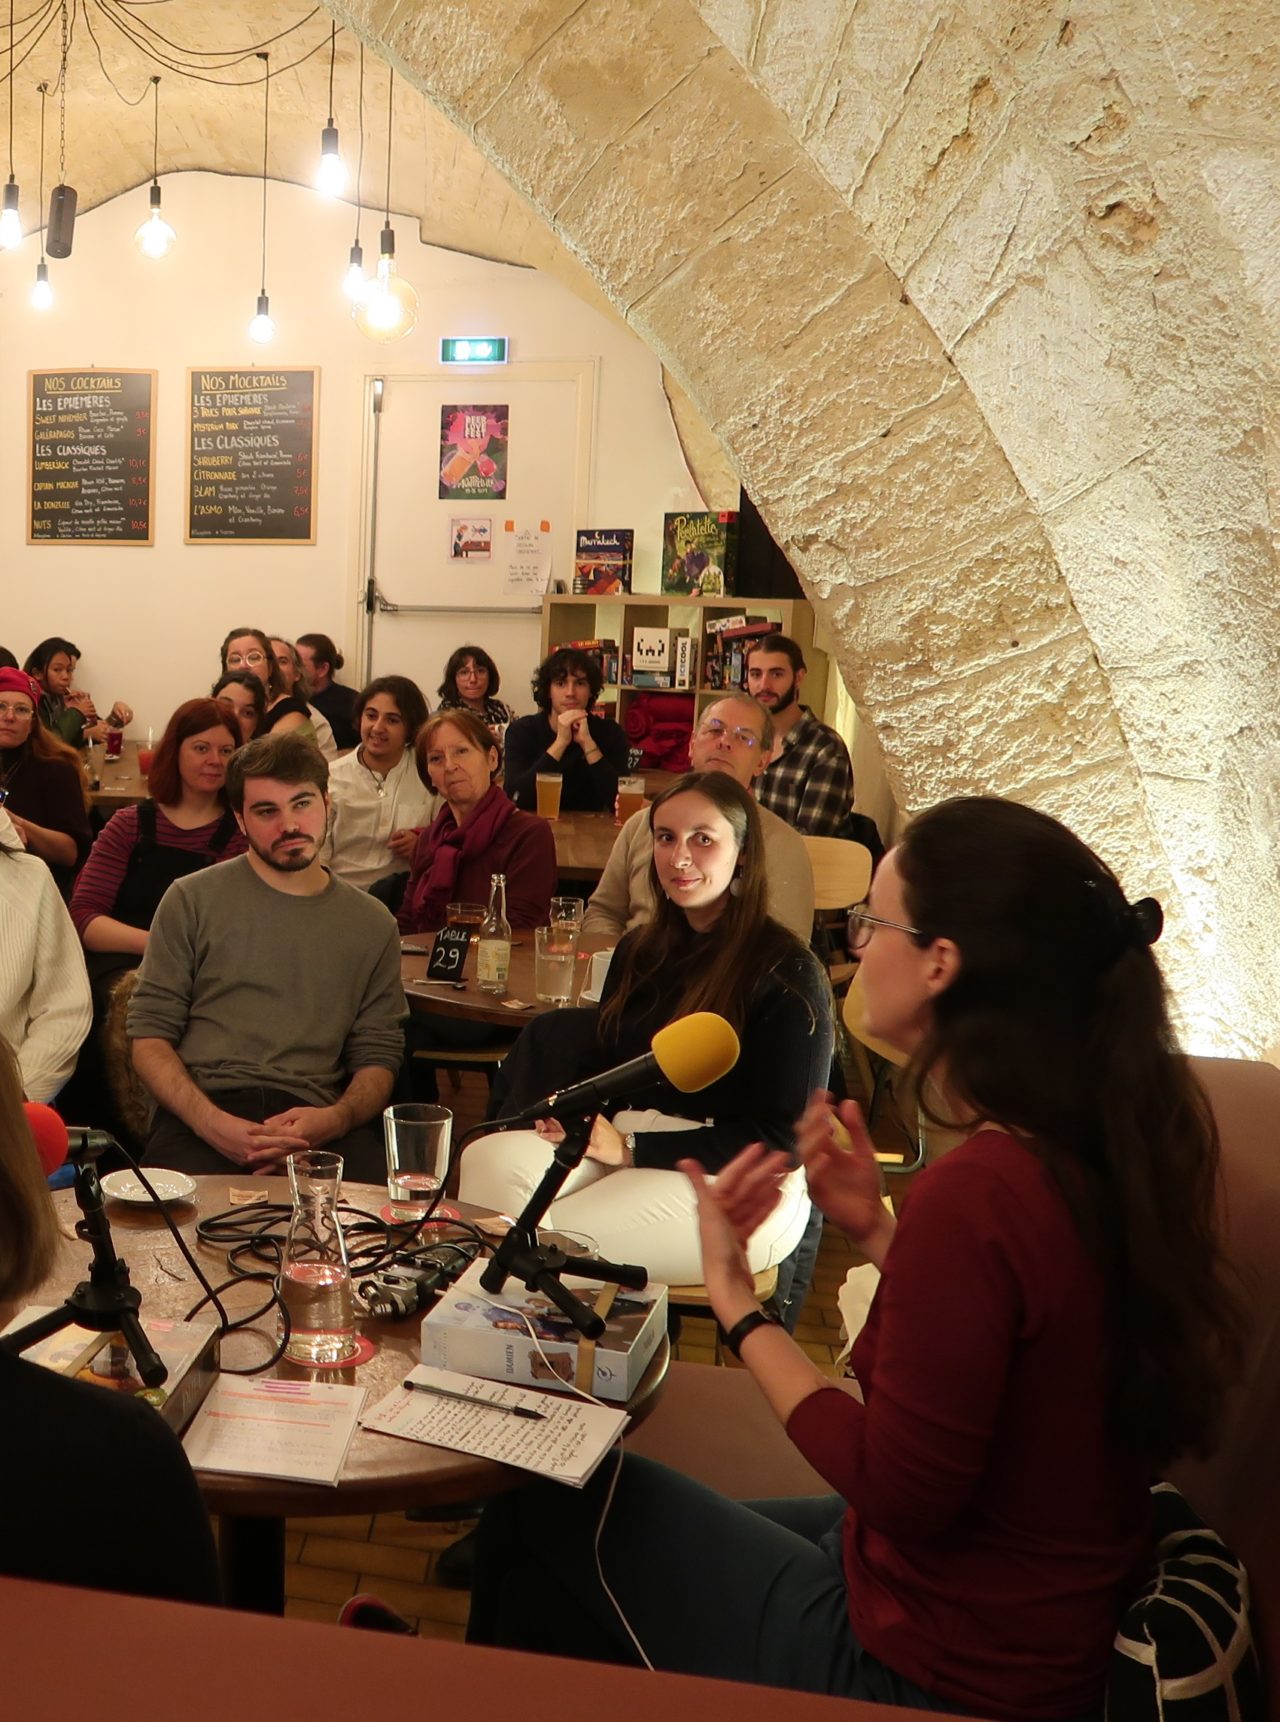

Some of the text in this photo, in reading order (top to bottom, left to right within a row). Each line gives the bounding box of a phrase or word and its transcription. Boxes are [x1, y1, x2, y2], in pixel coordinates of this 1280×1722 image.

[44, 377, 65, 391] NOS
[201, 374, 225, 390] NOS
[36, 397, 53, 410] LES
[194, 394, 212, 406] LES
[36, 443, 52, 456] LES
[194, 436, 214, 450] LES
[437, 926, 468, 942] TABLE
[433, 947, 460, 970] 29
[505, 1343, 515, 1375] DAMIEN
